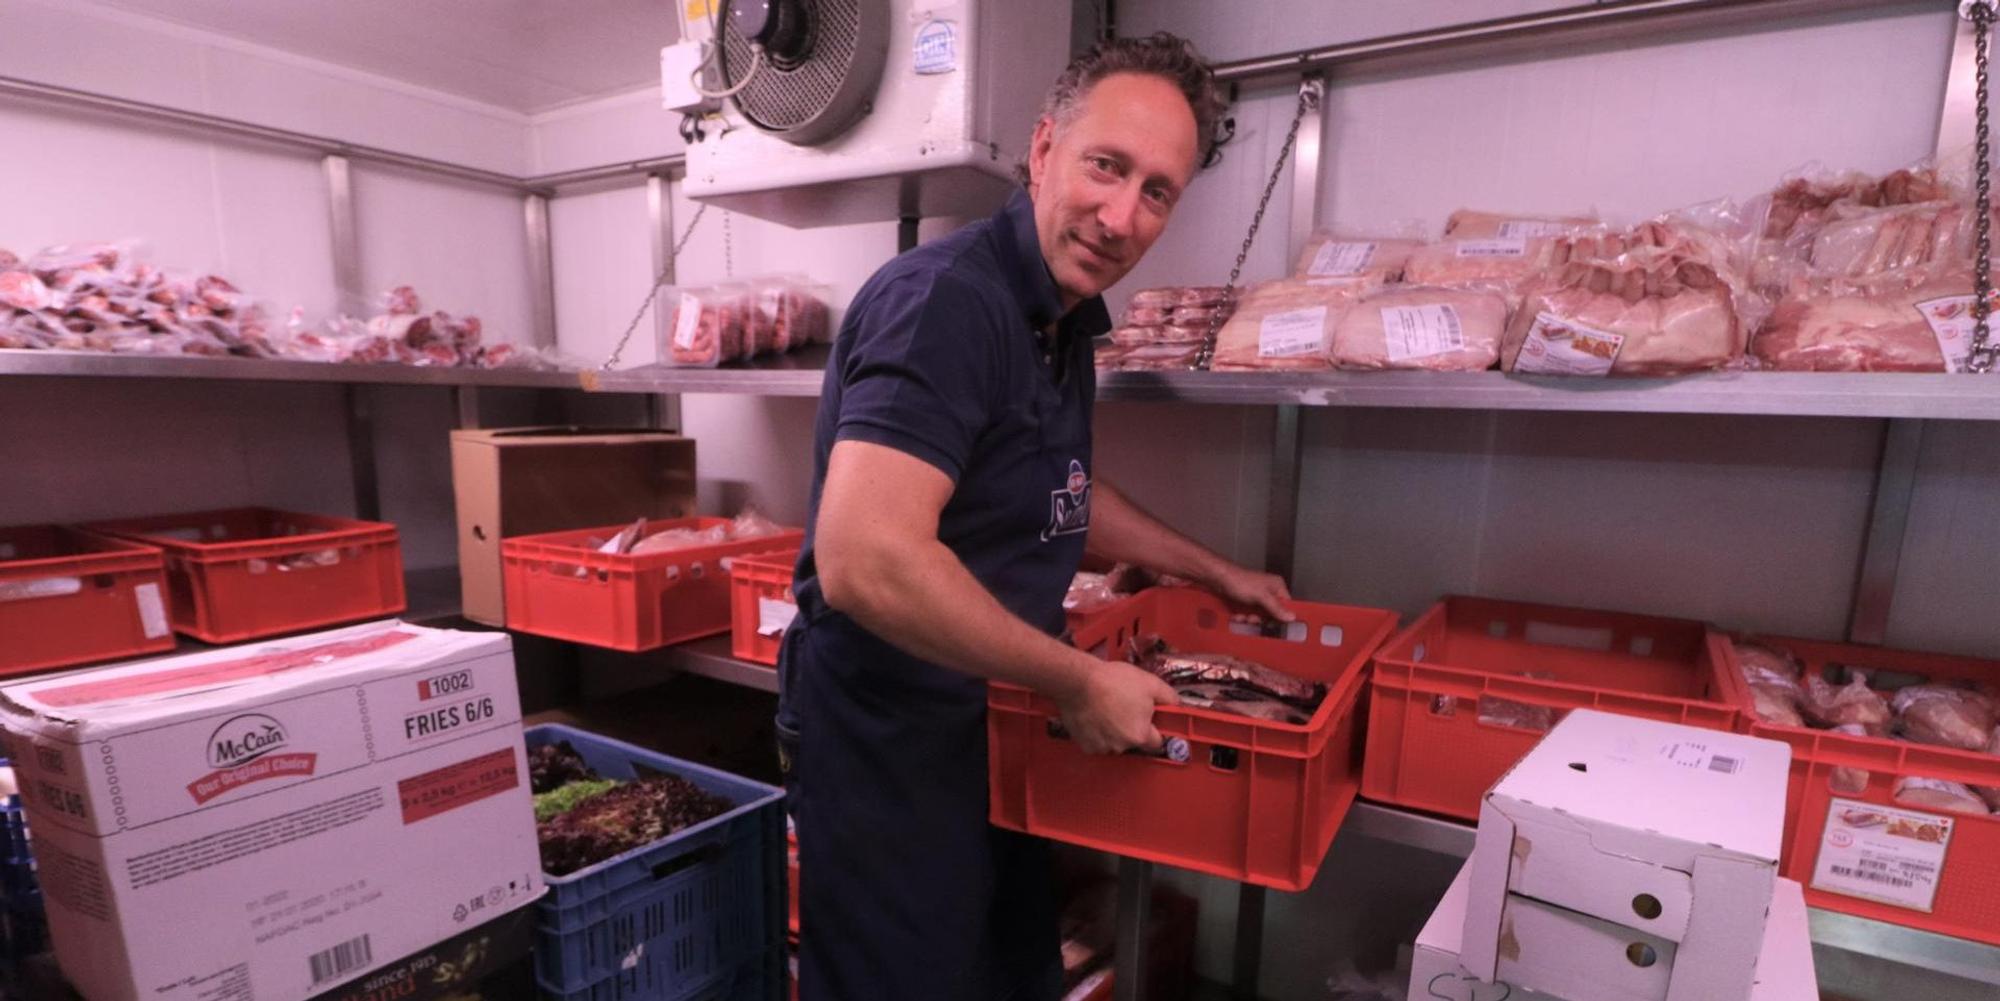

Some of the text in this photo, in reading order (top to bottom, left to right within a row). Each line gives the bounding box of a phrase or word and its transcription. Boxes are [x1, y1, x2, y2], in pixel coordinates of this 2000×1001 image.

[432, 672, 469, 694] 1002
[404, 697, 494, 739] FRIES 6/6
[216, 725, 284, 763] McCain
[196, 757, 310, 796] Our Original Choice
[363, 967, 408, 992] since
